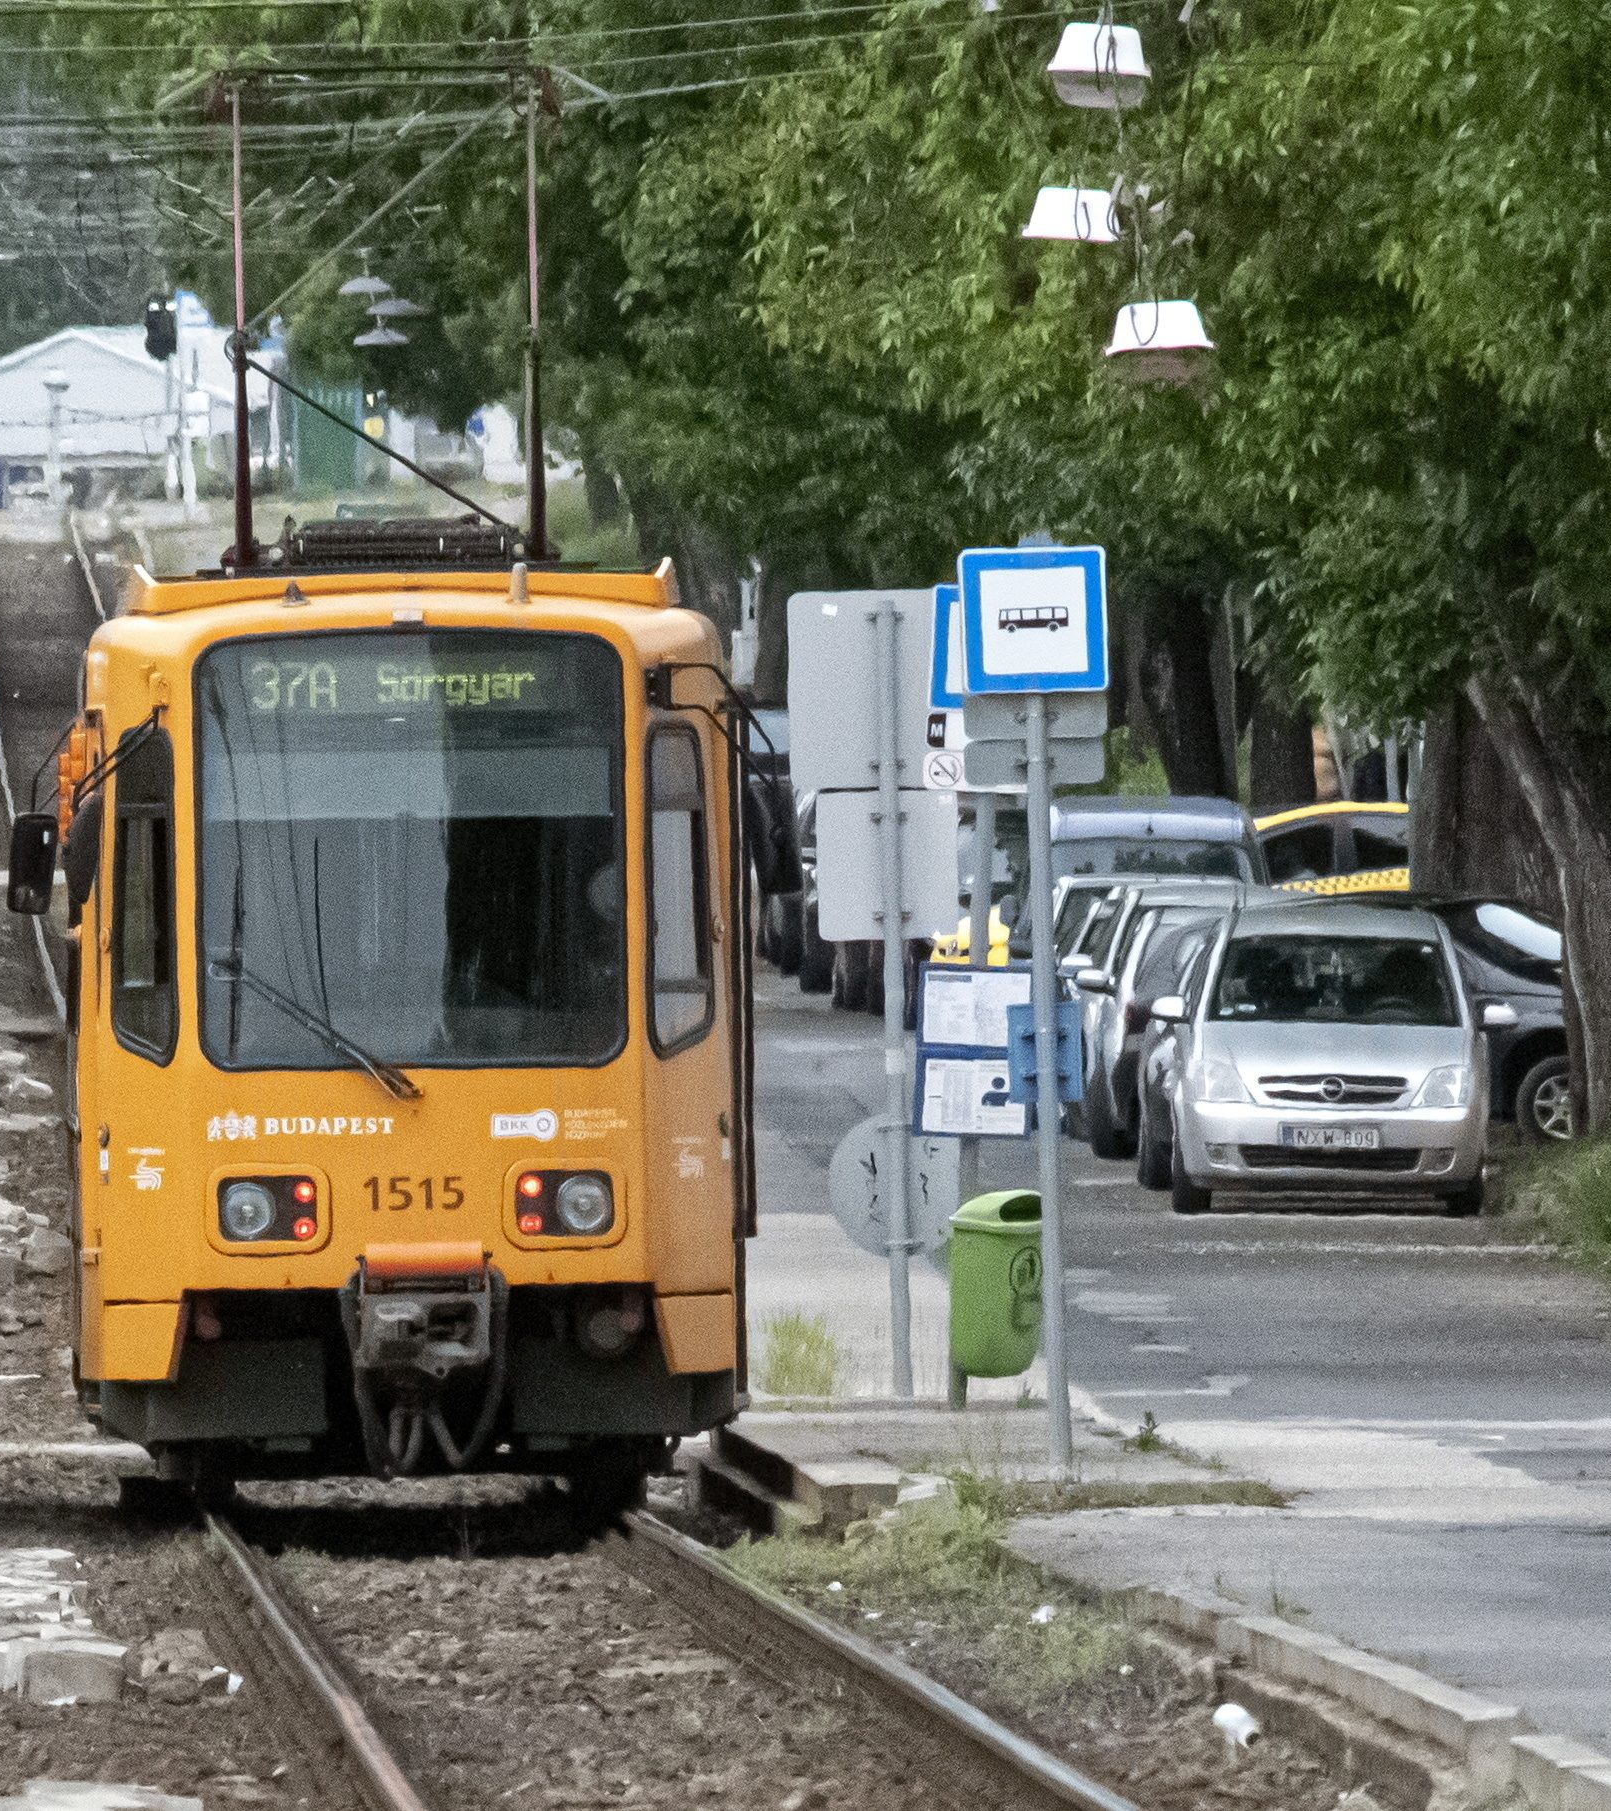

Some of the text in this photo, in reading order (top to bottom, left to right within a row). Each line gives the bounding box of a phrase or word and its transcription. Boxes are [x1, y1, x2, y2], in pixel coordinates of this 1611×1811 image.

[252, 661, 338, 709] 37A
[264, 1117, 395, 1136] BUDAPEST
[500, 1119, 529, 1131] BKK
[363, 1175, 465, 1212] 1515
